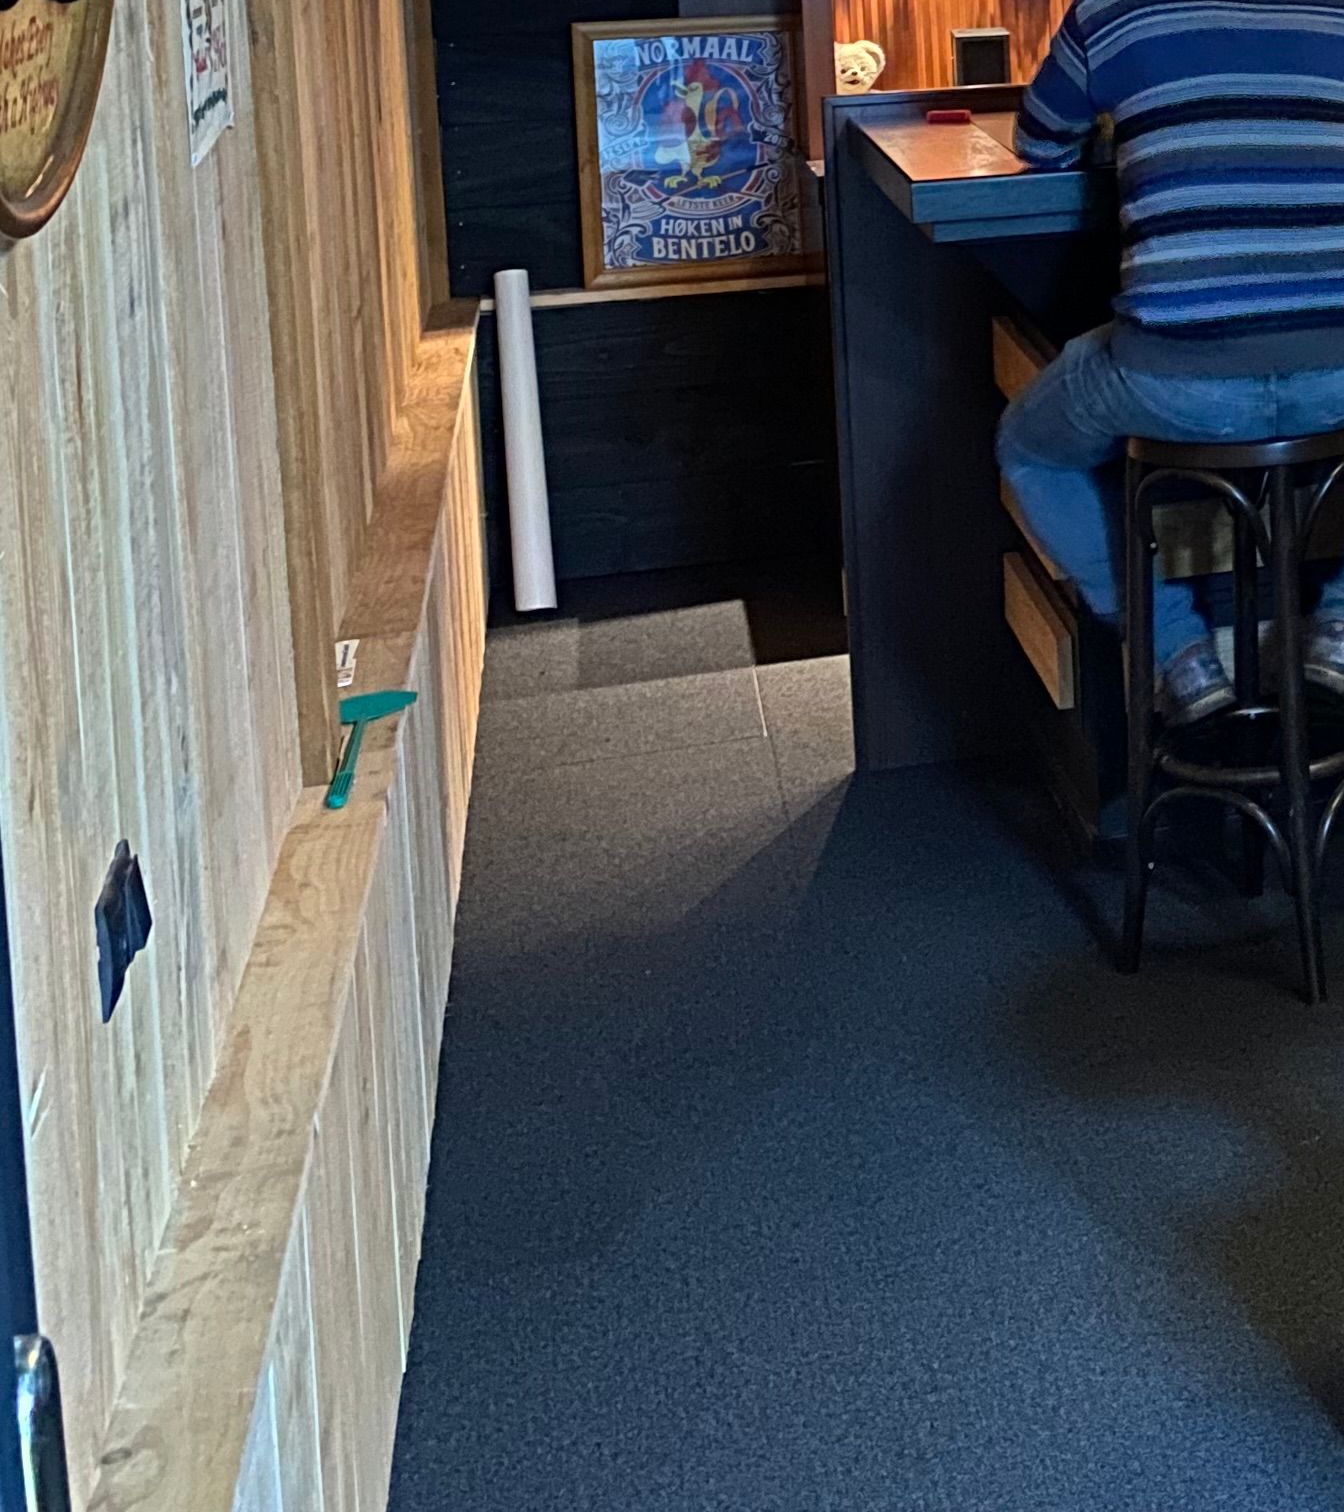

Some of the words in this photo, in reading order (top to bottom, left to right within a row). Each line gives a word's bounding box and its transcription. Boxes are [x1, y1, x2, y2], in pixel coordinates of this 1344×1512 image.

[635, 36, 753, 65] NORMAAL
[660, 217, 726, 237] HØKEN
[728, 214, 743, 231] IN
[652, 231, 756, 260] BENTELO
